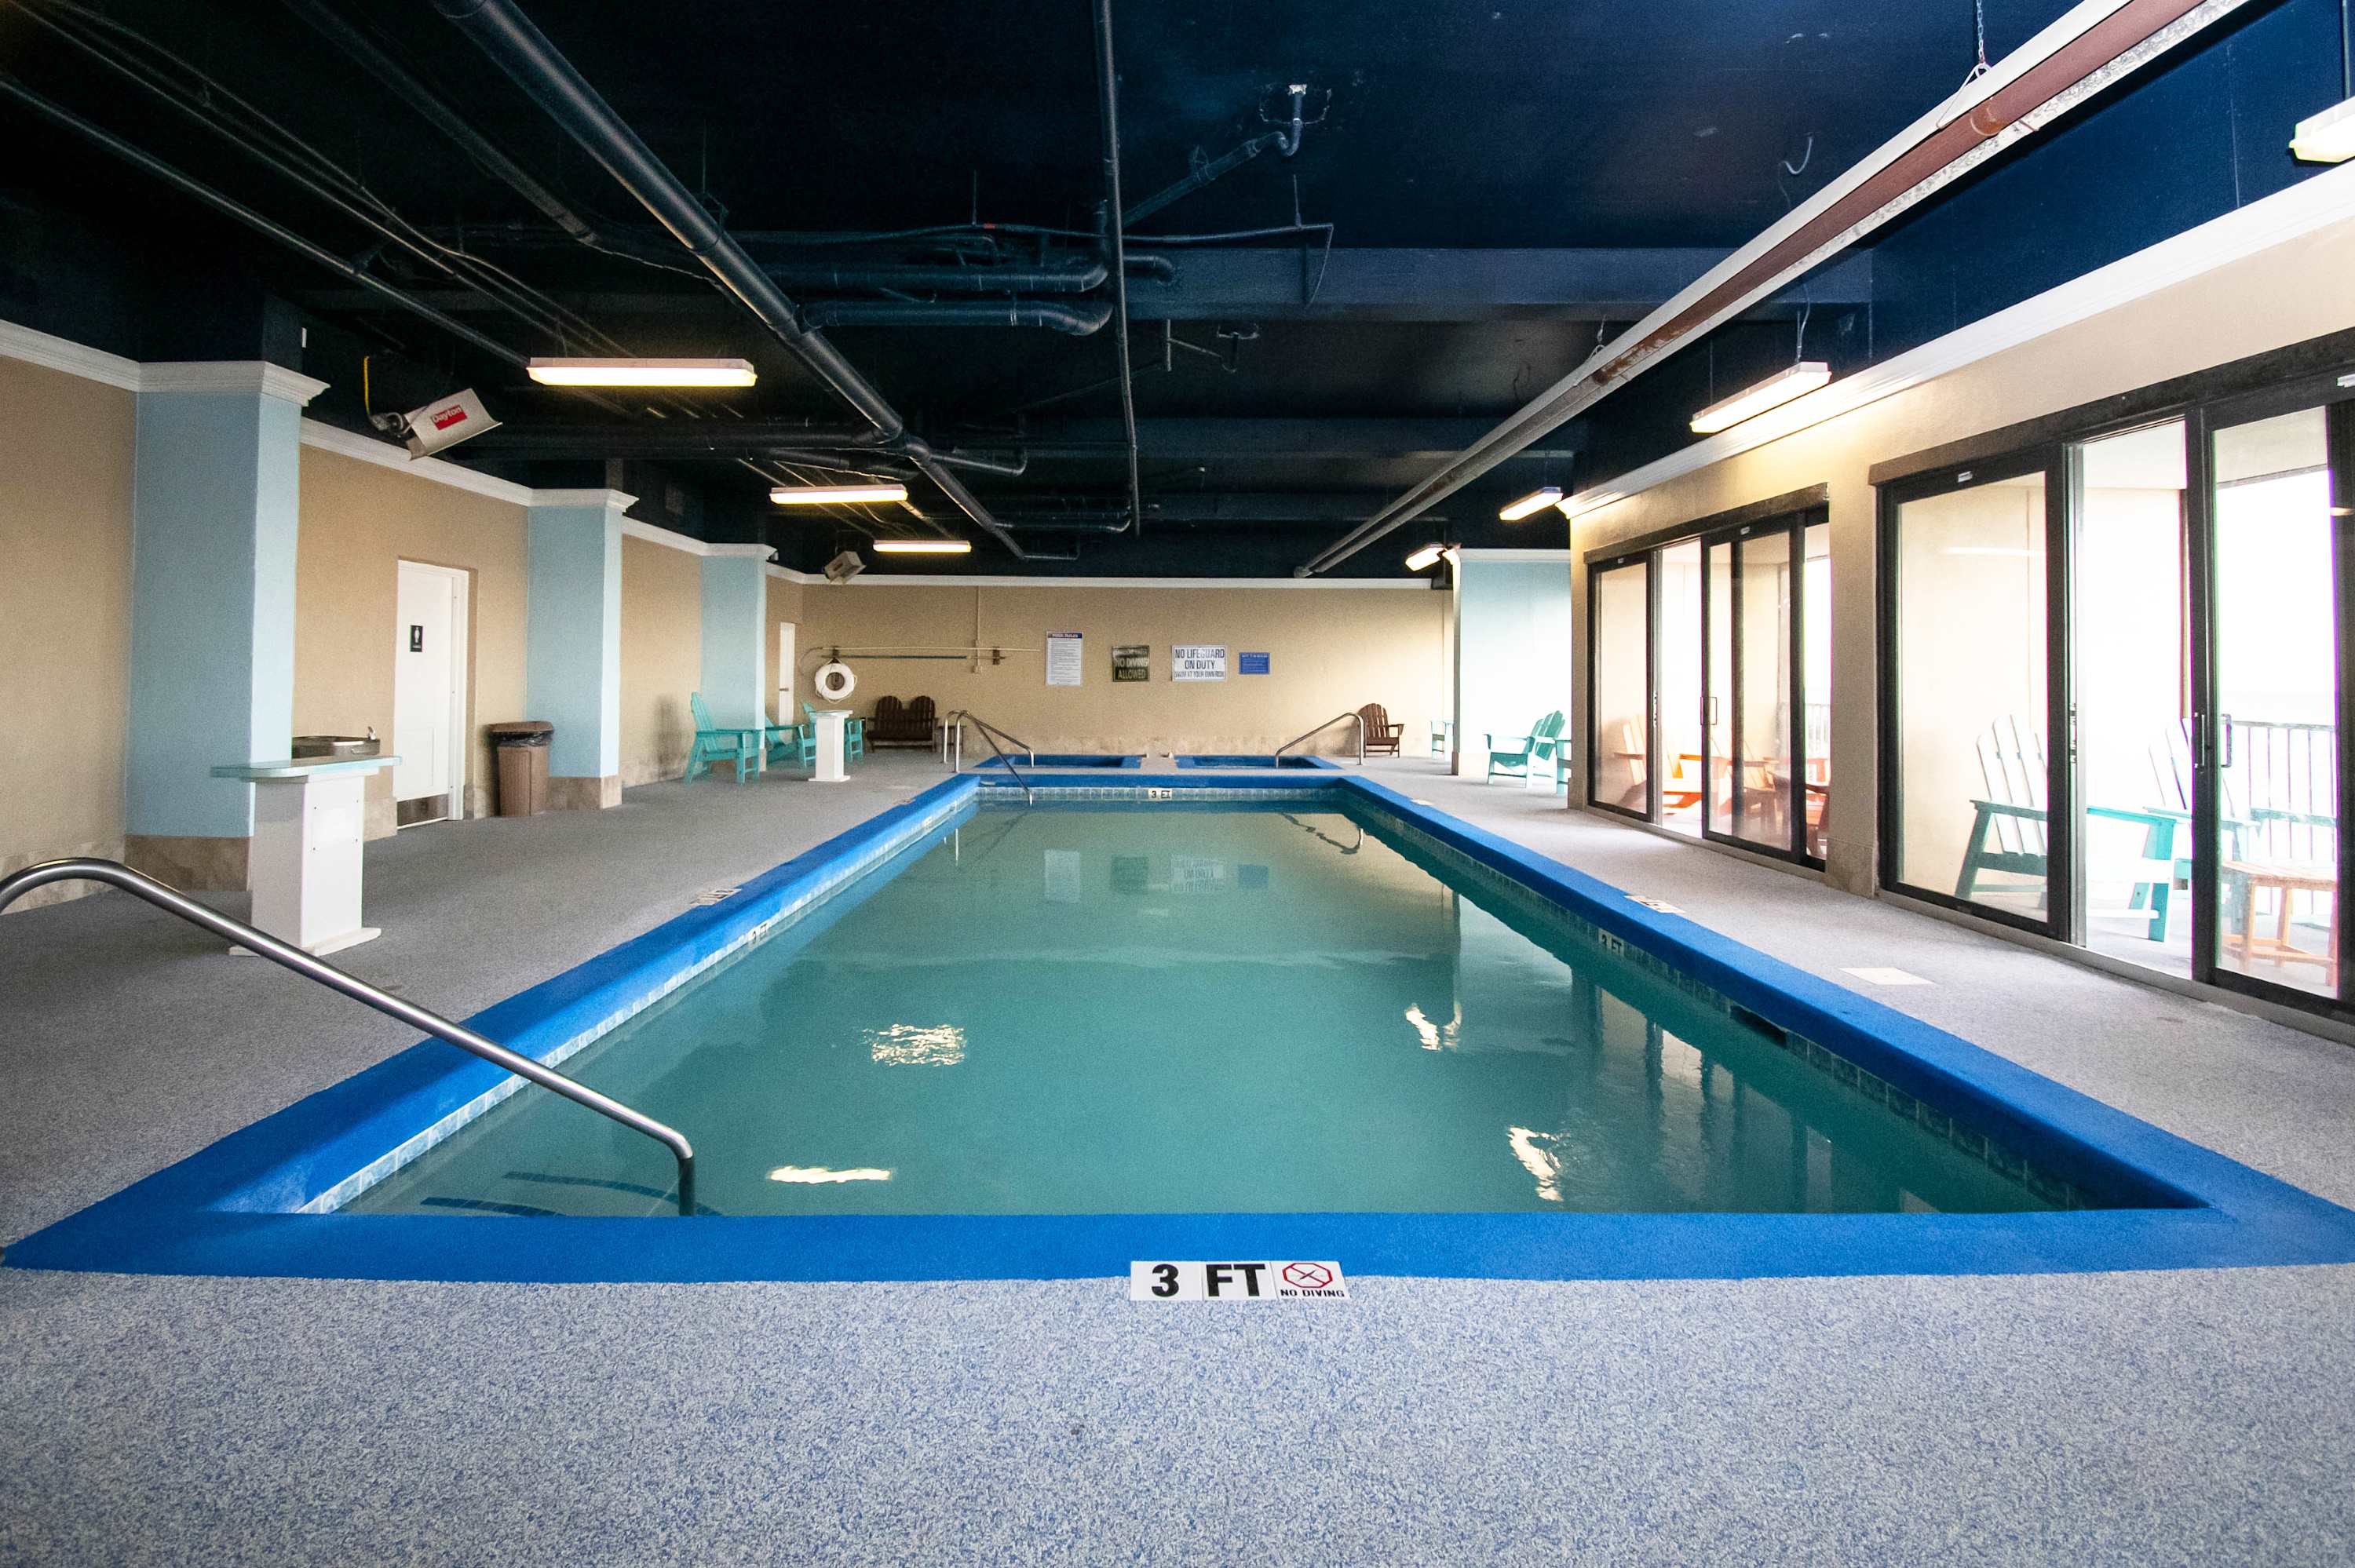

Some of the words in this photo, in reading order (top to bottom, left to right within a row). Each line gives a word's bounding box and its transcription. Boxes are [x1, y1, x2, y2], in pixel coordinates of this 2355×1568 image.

[433, 407, 462, 423] Dayton
[1175, 649, 1185, 658] NO
[1187, 649, 1225, 658] LIFEGUARD
[1115, 658, 1125, 667] NO
[1126, 658, 1148, 667] DIVING
[1185, 660, 1195, 669] ON
[1196, 660, 1216, 669] DUTY
[1118, 669, 1146, 679] ALLOWED
[1152, 1264, 1179, 1297] 3
[1206, 1264, 1265, 1296] FT
[1302, 1289, 1345, 1297] DIVING
